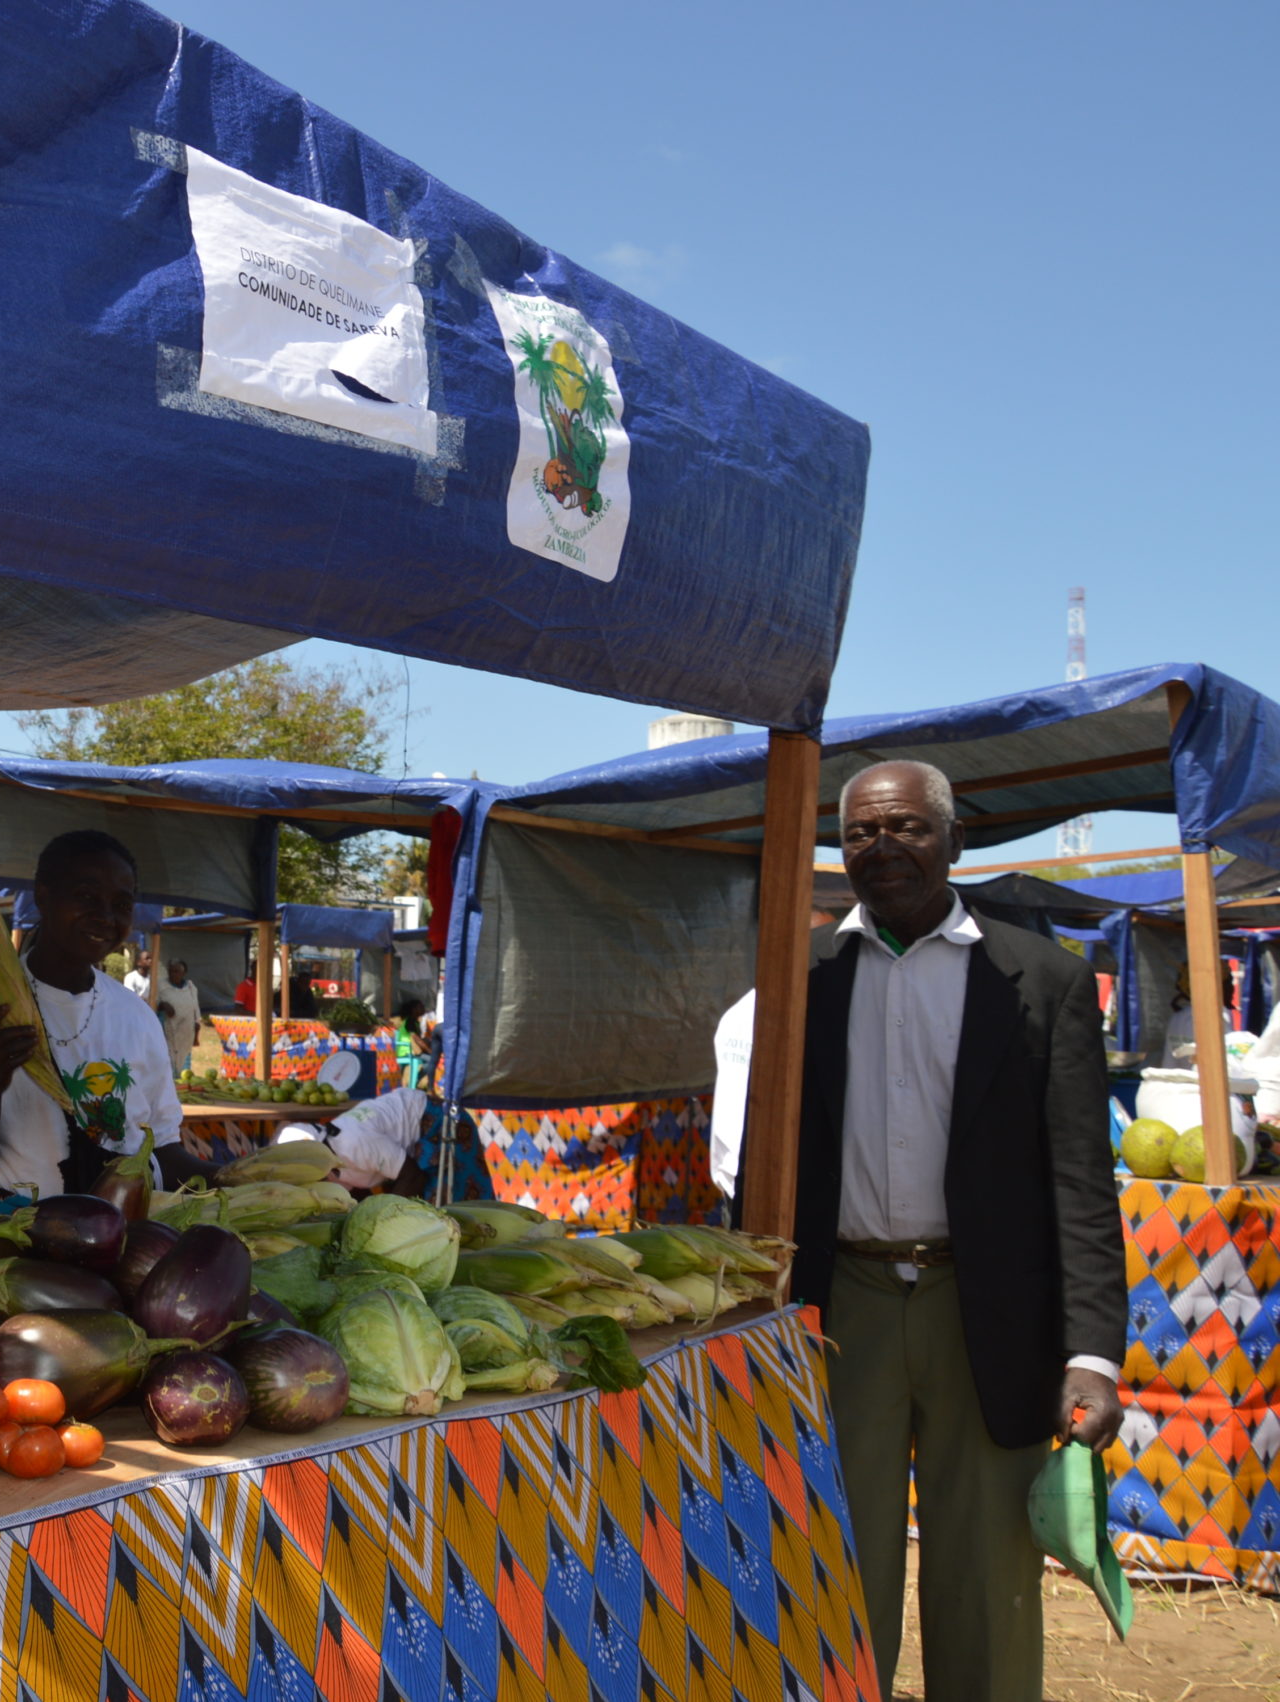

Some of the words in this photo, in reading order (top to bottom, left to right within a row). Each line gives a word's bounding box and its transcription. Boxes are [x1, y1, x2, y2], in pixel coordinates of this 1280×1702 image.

[238, 272, 322, 323] COMUNIDADE
[326, 310, 341, 329] DE
[240, 246, 296, 280] DISTRITO
[300, 270, 317, 290] DE
[319, 279, 384, 319] QUELIMANE
